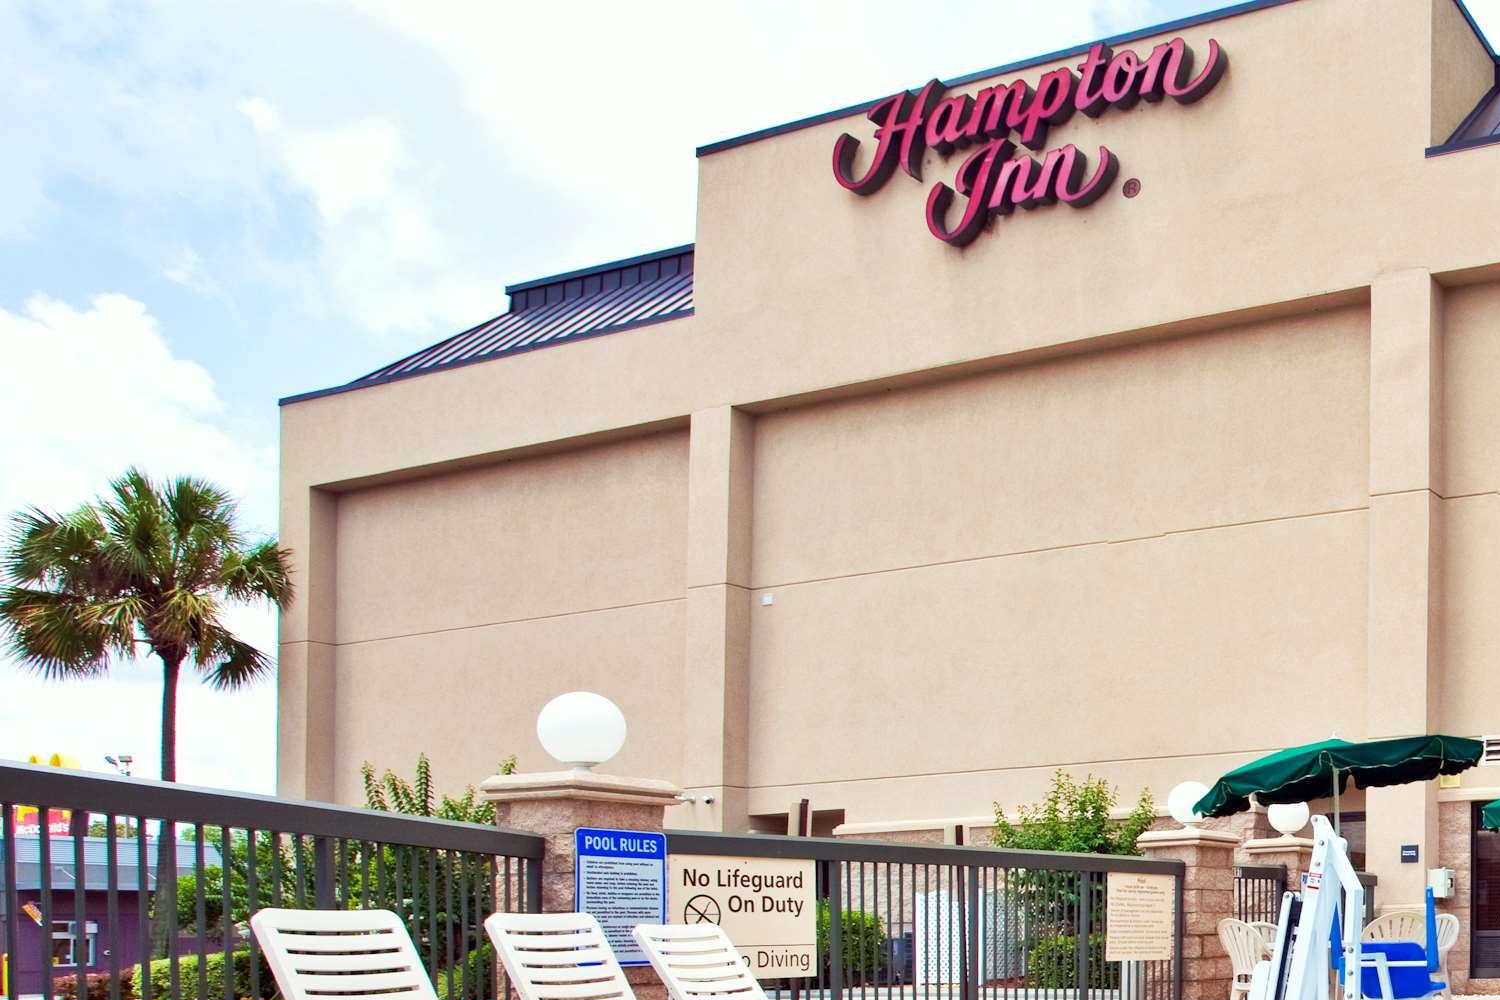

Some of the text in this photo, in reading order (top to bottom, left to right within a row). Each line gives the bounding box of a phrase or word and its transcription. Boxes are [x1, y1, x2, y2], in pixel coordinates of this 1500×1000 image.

[832, 37, 1230, 196] Hampton
[926, 138, 1120, 248] Inn
[584, 835, 657, 853] POOL RULES
[683, 868, 803, 893] No Lifeguard
[728, 895, 804, 917] On Duty
[757, 949, 810, 972] Diving
